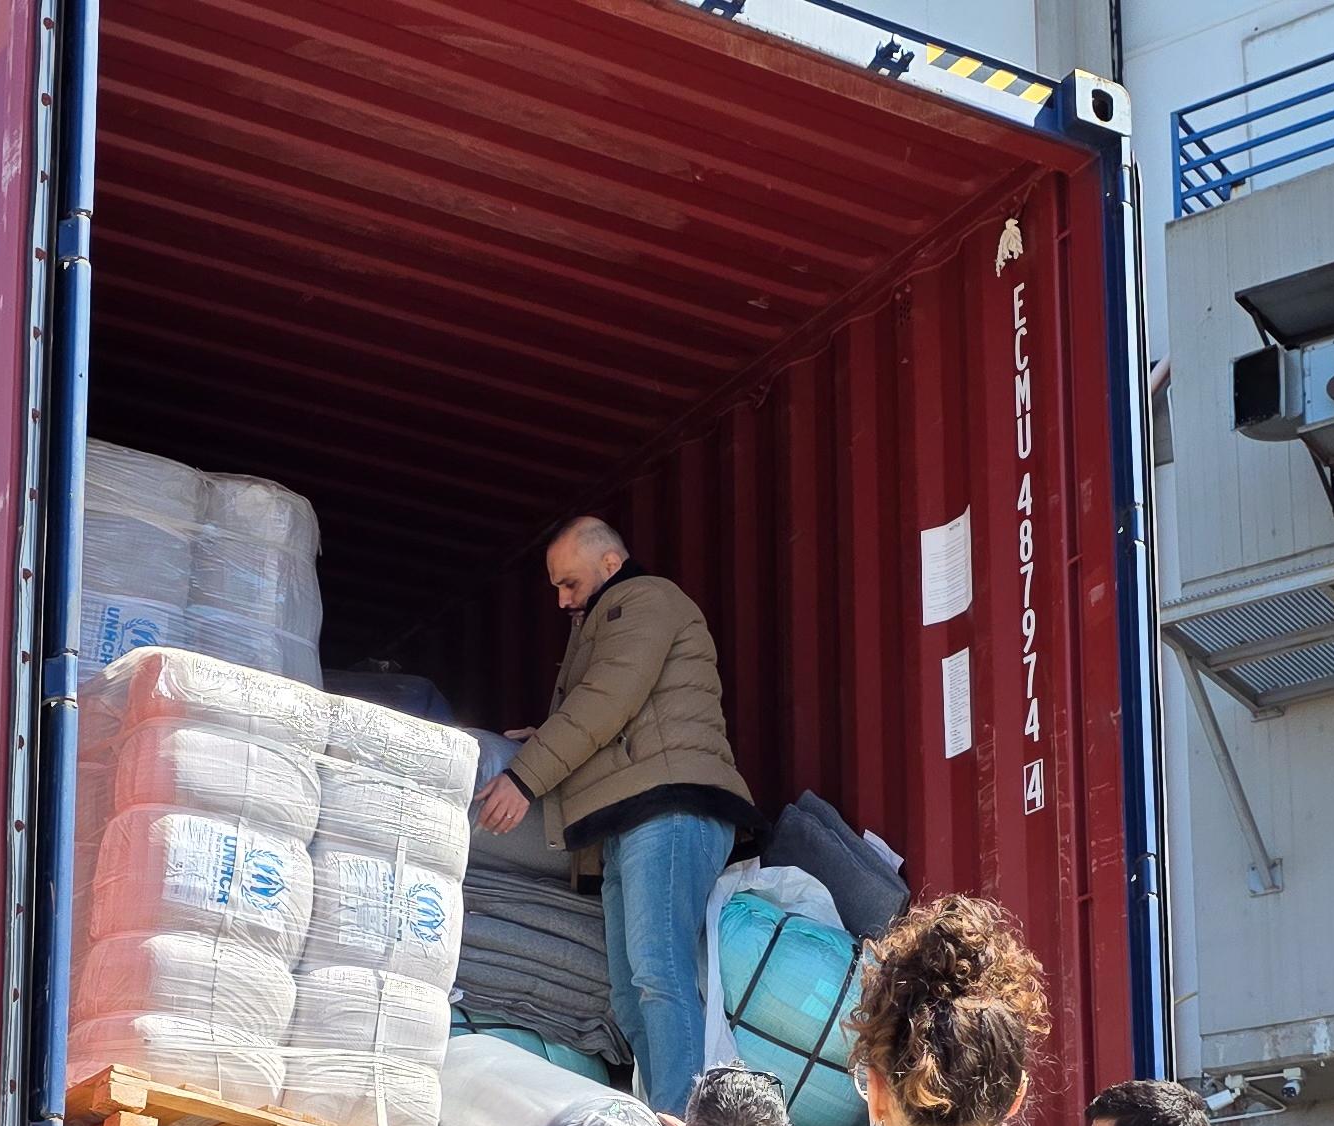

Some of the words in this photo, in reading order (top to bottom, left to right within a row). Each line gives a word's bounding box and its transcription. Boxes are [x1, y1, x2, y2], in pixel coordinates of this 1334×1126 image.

[1013, 282, 1033, 460] ECMU
[1017, 472, 1041, 742] 487974
[1026, 762, 1042, 809] 4
[216, 834, 238, 905] UNHCR
